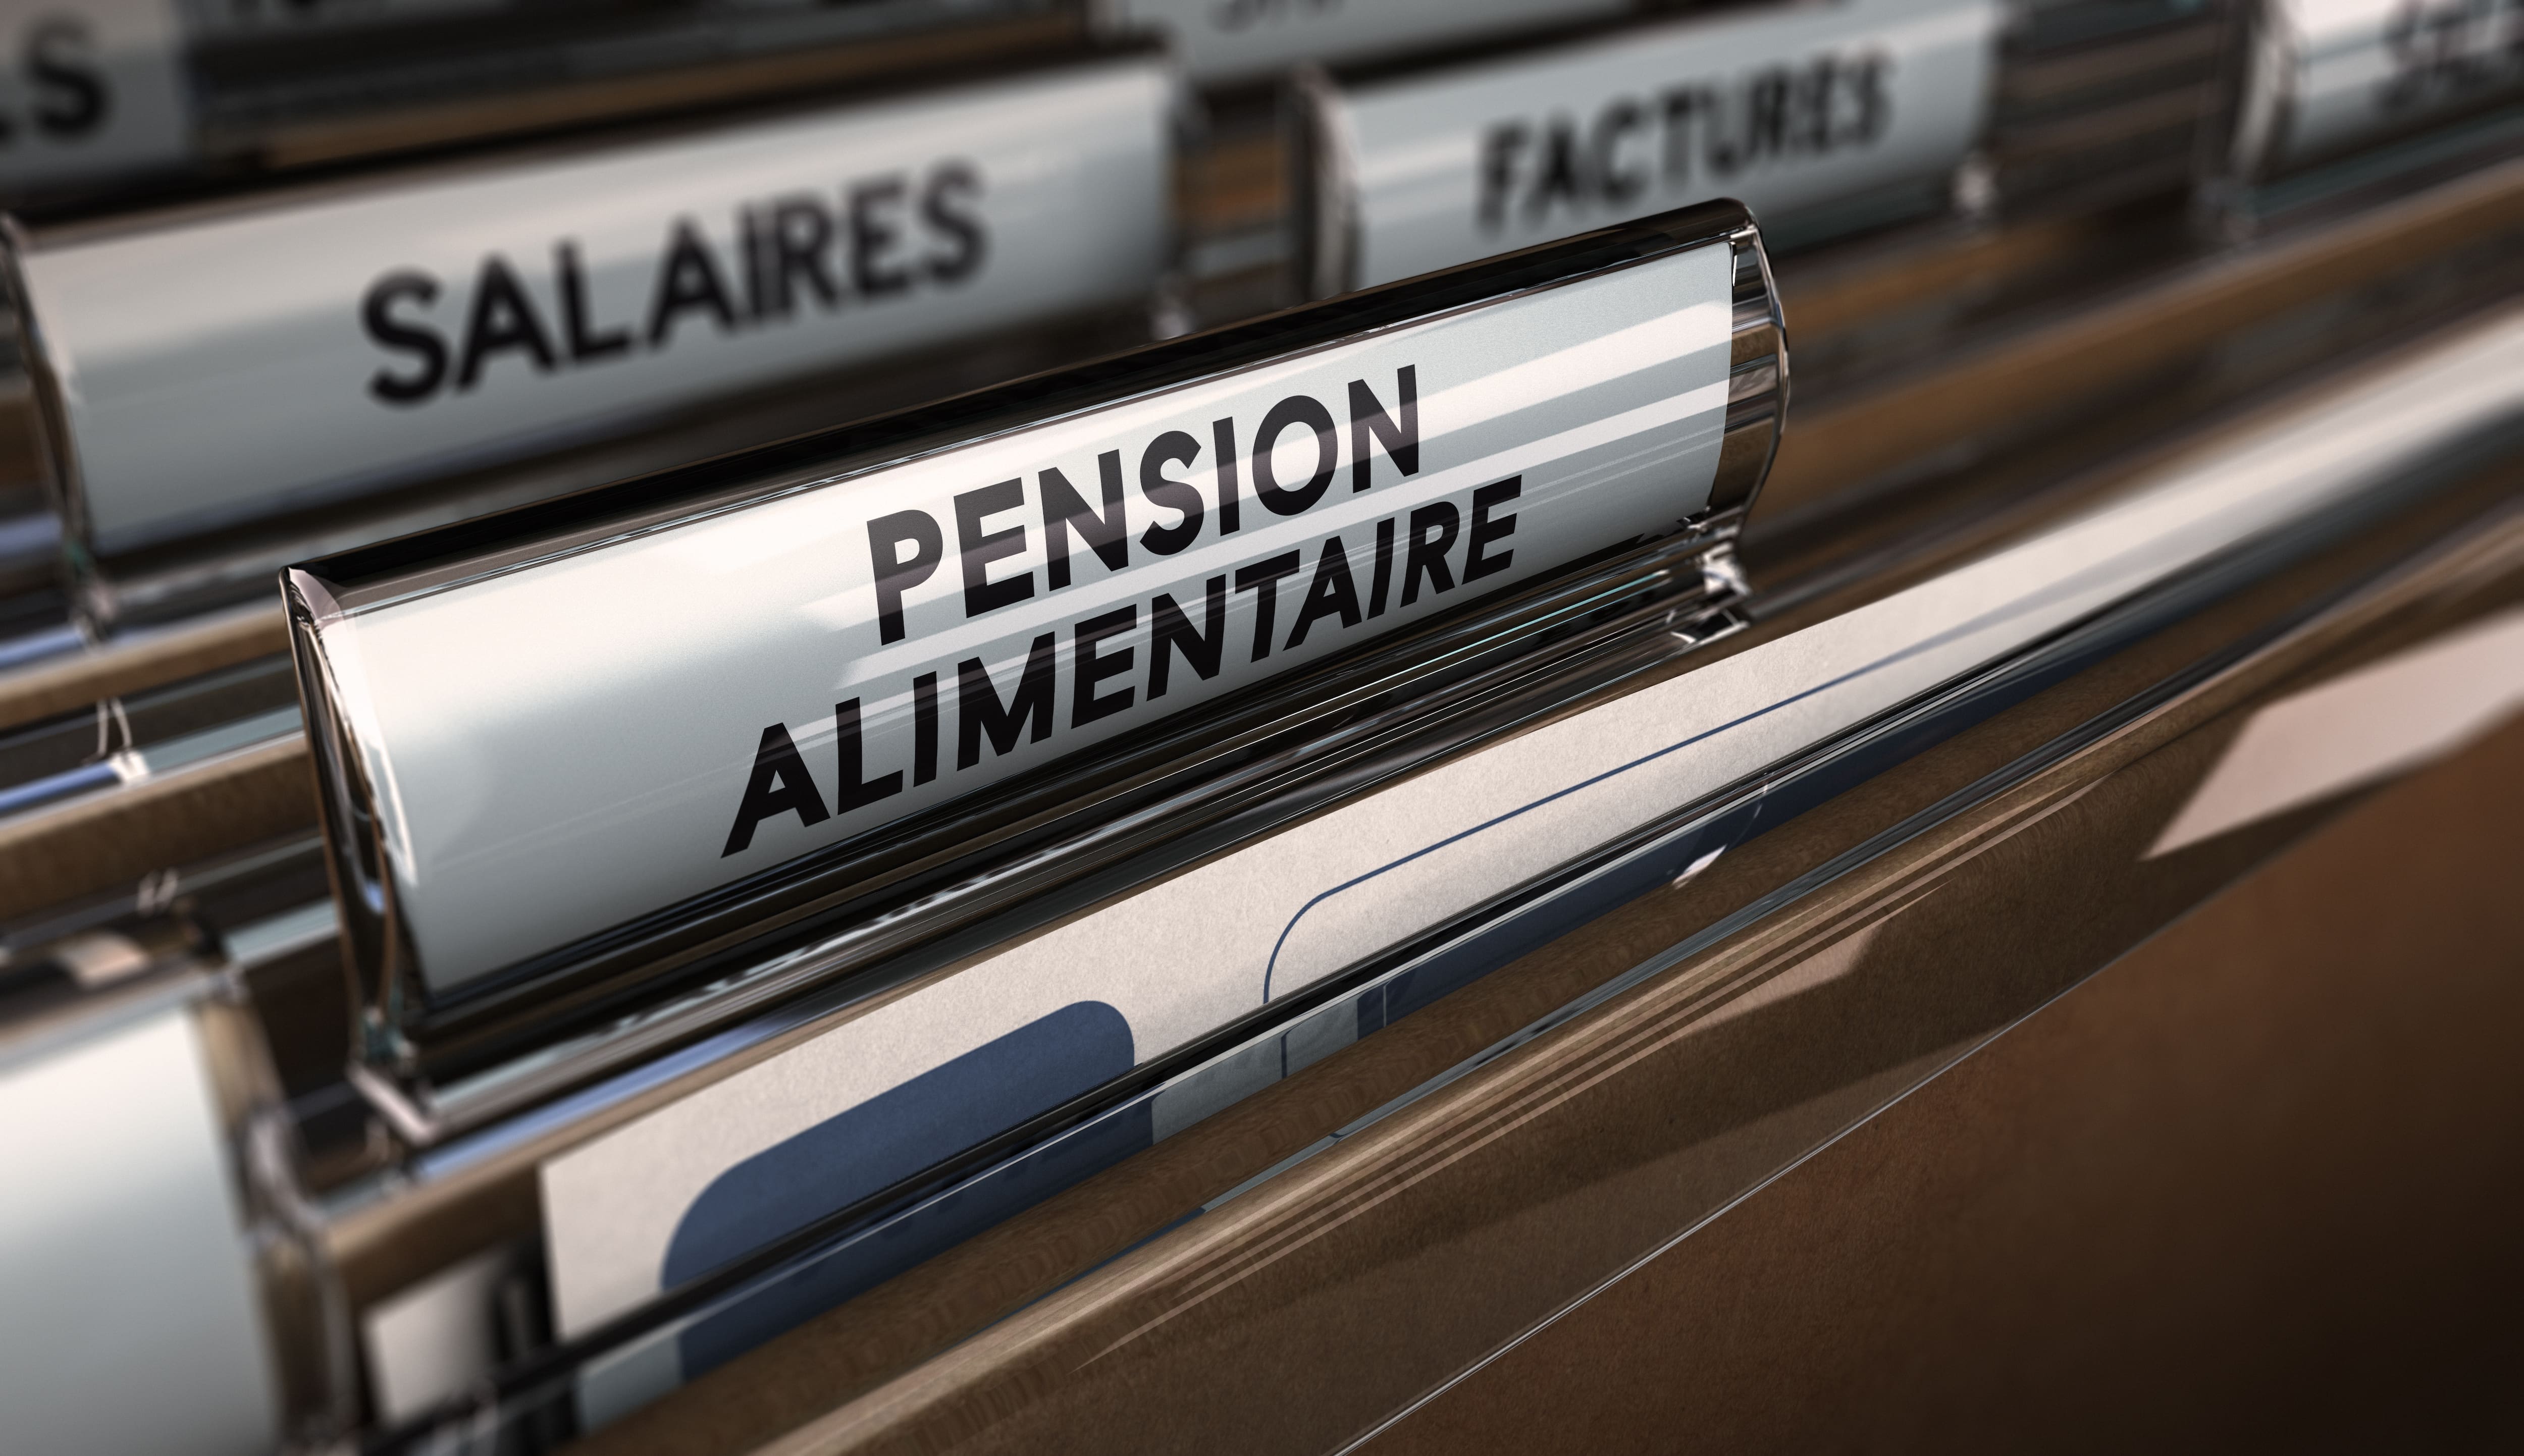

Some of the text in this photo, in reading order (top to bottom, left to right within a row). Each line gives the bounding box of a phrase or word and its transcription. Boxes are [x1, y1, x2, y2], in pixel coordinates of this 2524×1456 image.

[1479, 48, 1893, 235] FACTURES
[359, 161, 988, 404] SALAIRES
[867, 364, 1421, 645] PENSION
[722, 474, 1522, 858] ALIMENTAIRE
